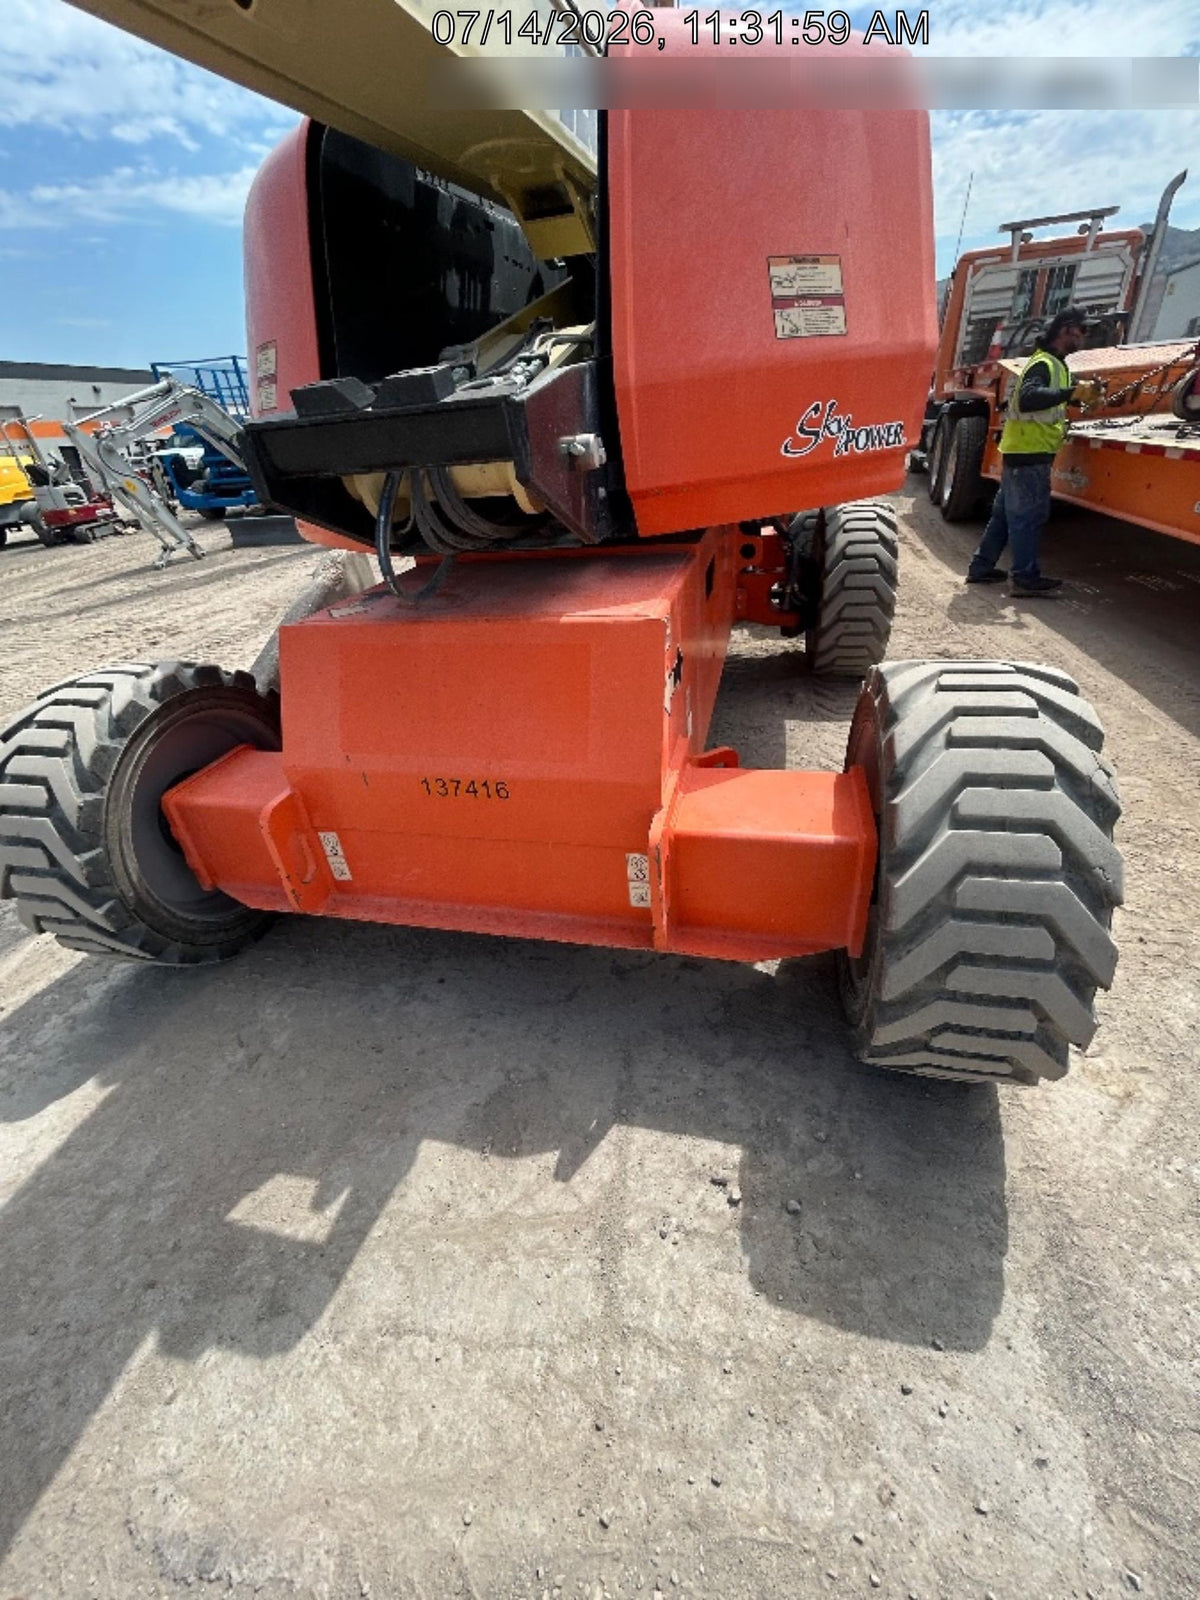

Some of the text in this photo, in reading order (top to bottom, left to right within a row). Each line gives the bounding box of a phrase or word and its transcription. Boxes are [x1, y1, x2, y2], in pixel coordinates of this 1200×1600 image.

[781, 400, 852, 458] Sky
[843, 421, 906, 455] POWER
[420, 777, 510, 800] 137416
